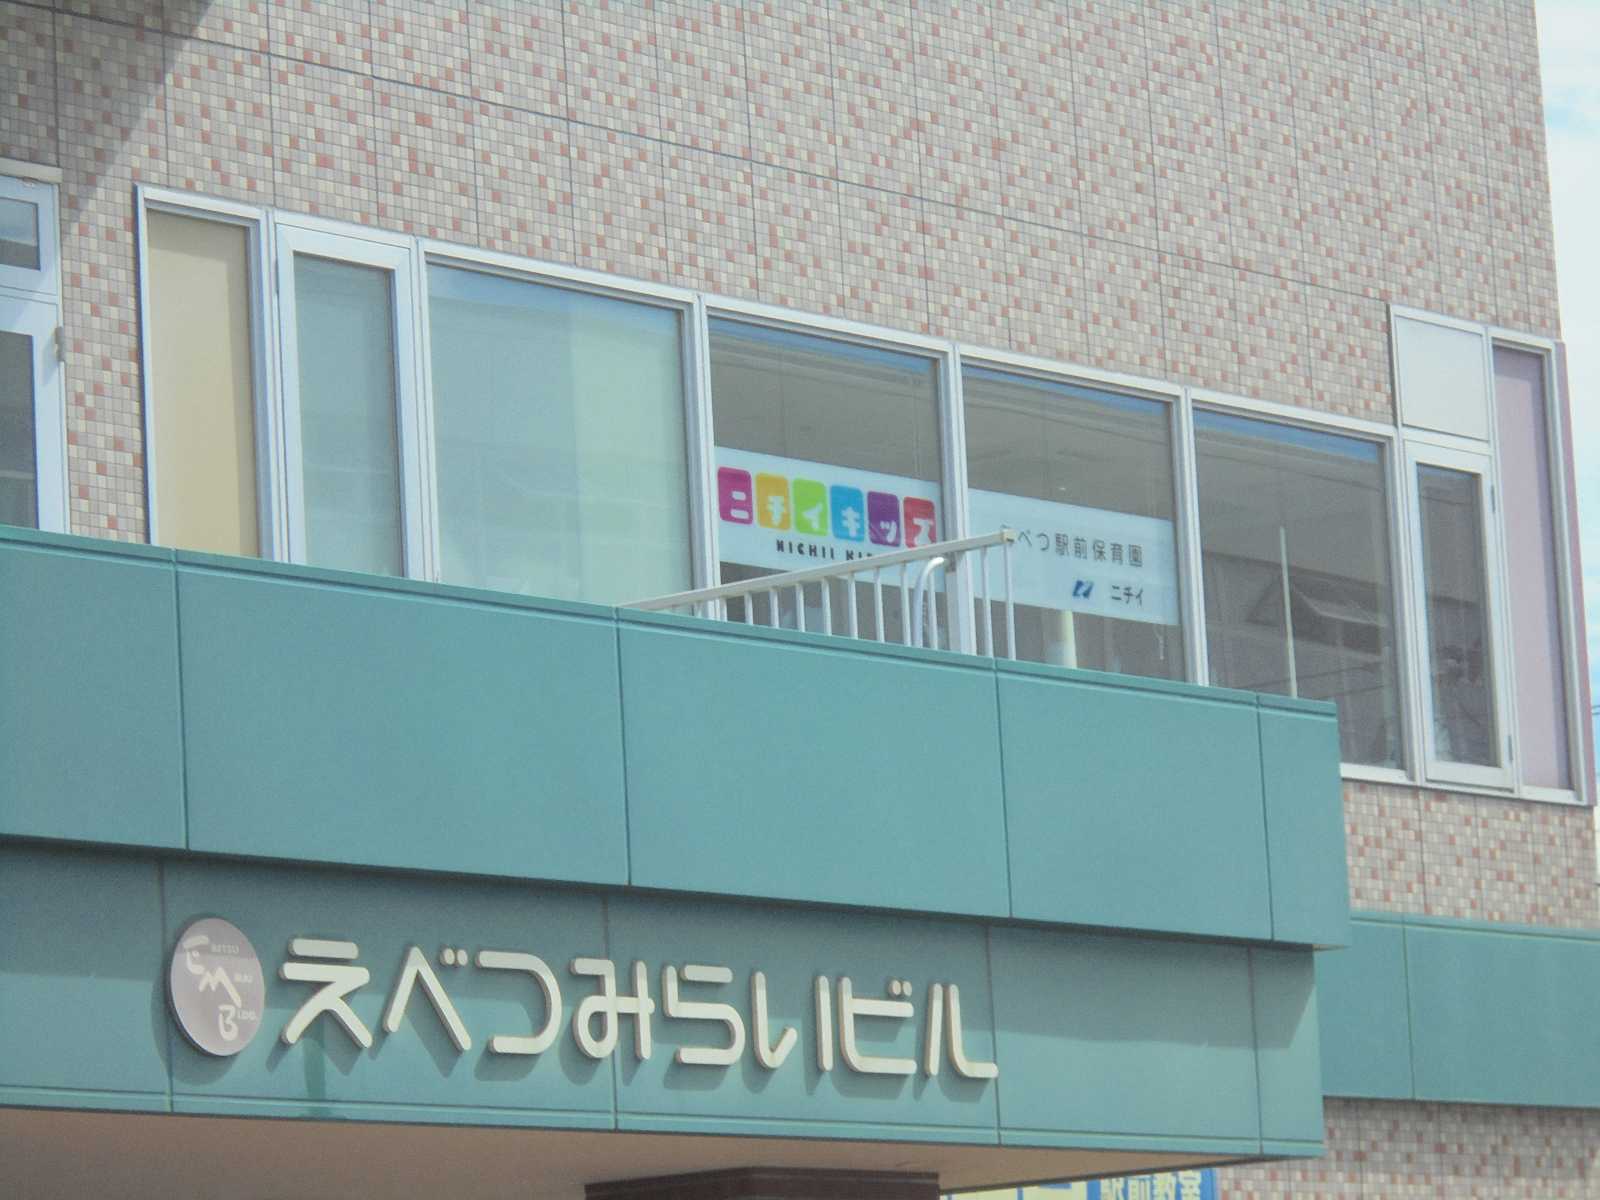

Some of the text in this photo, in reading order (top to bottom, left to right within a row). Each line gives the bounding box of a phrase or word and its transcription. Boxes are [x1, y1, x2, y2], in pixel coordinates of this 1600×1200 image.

[1001, 524, 1143, 567] べつ駅前保育園
[1111, 584, 1143, 605] ニチイ
[280, 938, 999, 1078] えべつみらいビル
